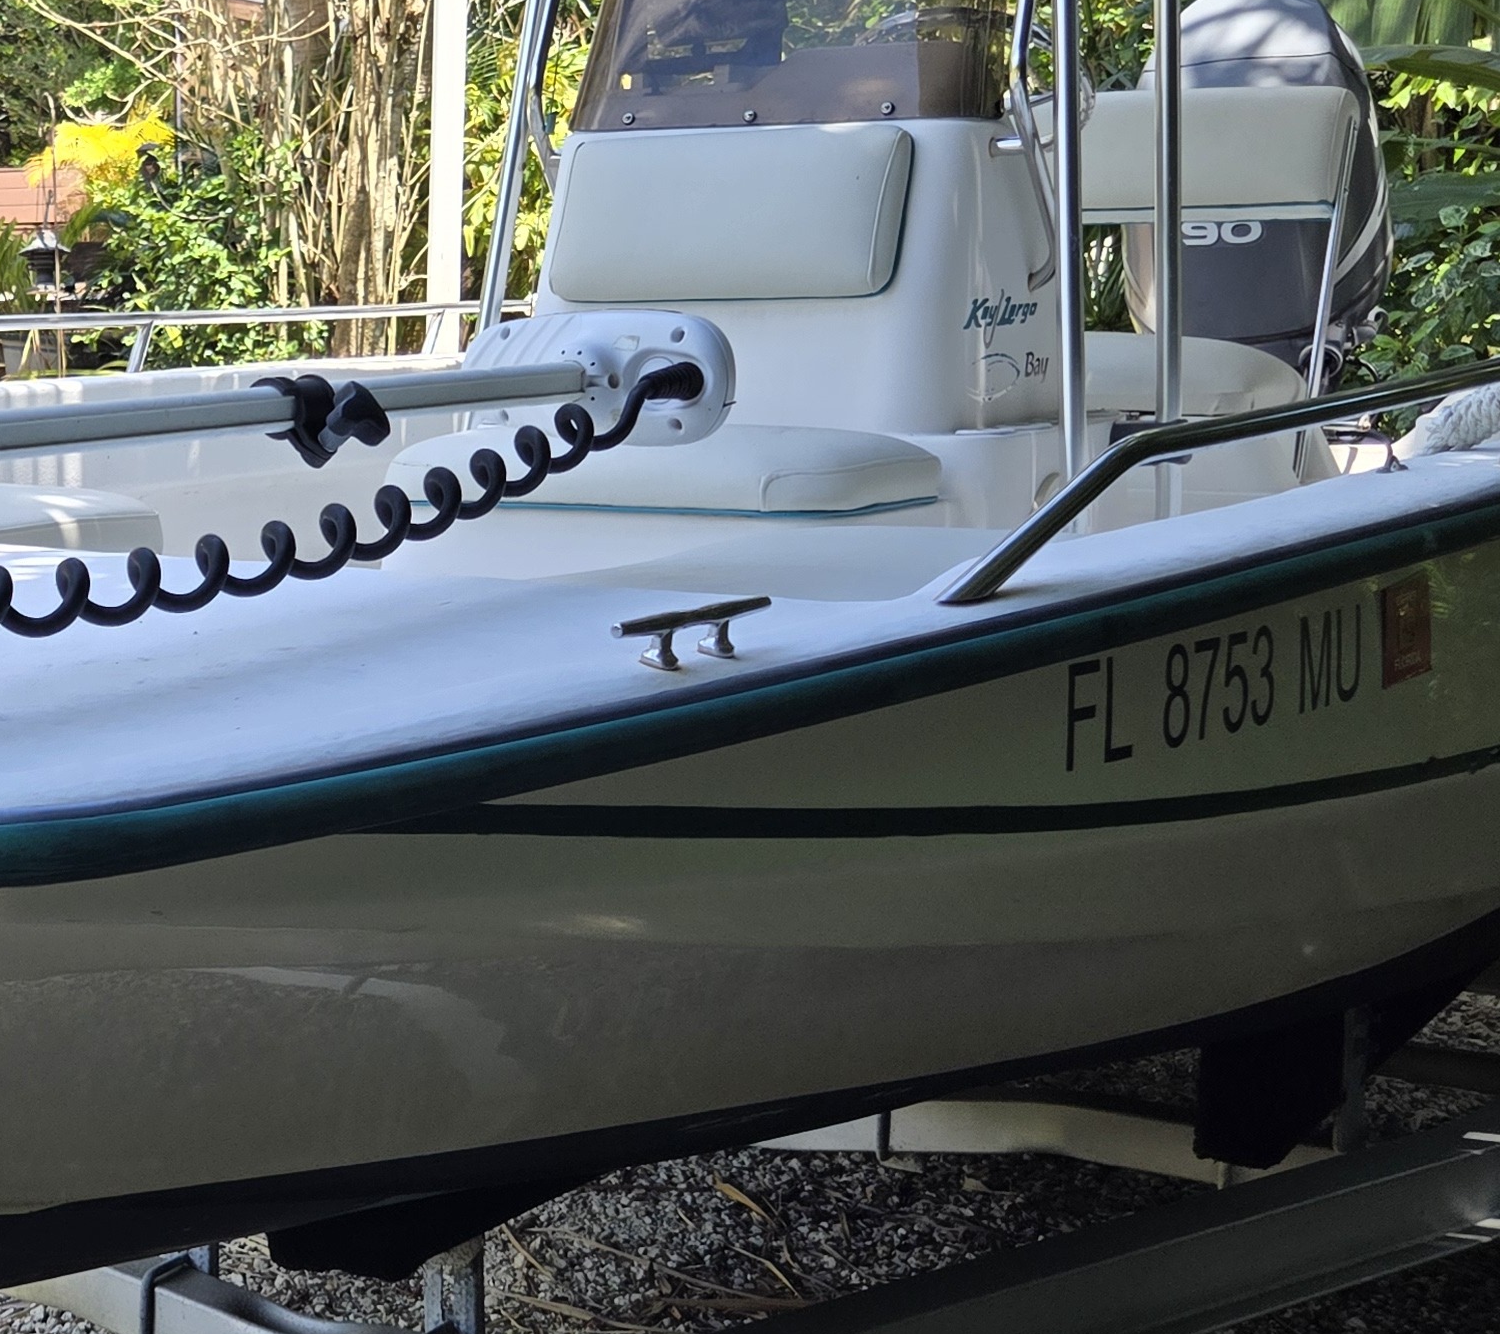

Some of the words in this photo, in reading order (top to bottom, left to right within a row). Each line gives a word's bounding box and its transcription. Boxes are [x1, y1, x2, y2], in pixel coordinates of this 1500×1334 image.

[1024, 351, 1050, 383] Bay
[1066, 656, 1133, 772] FL
[1162, 624, 1274, 749] 8753
[1299, 603, 1362, 714] MU
